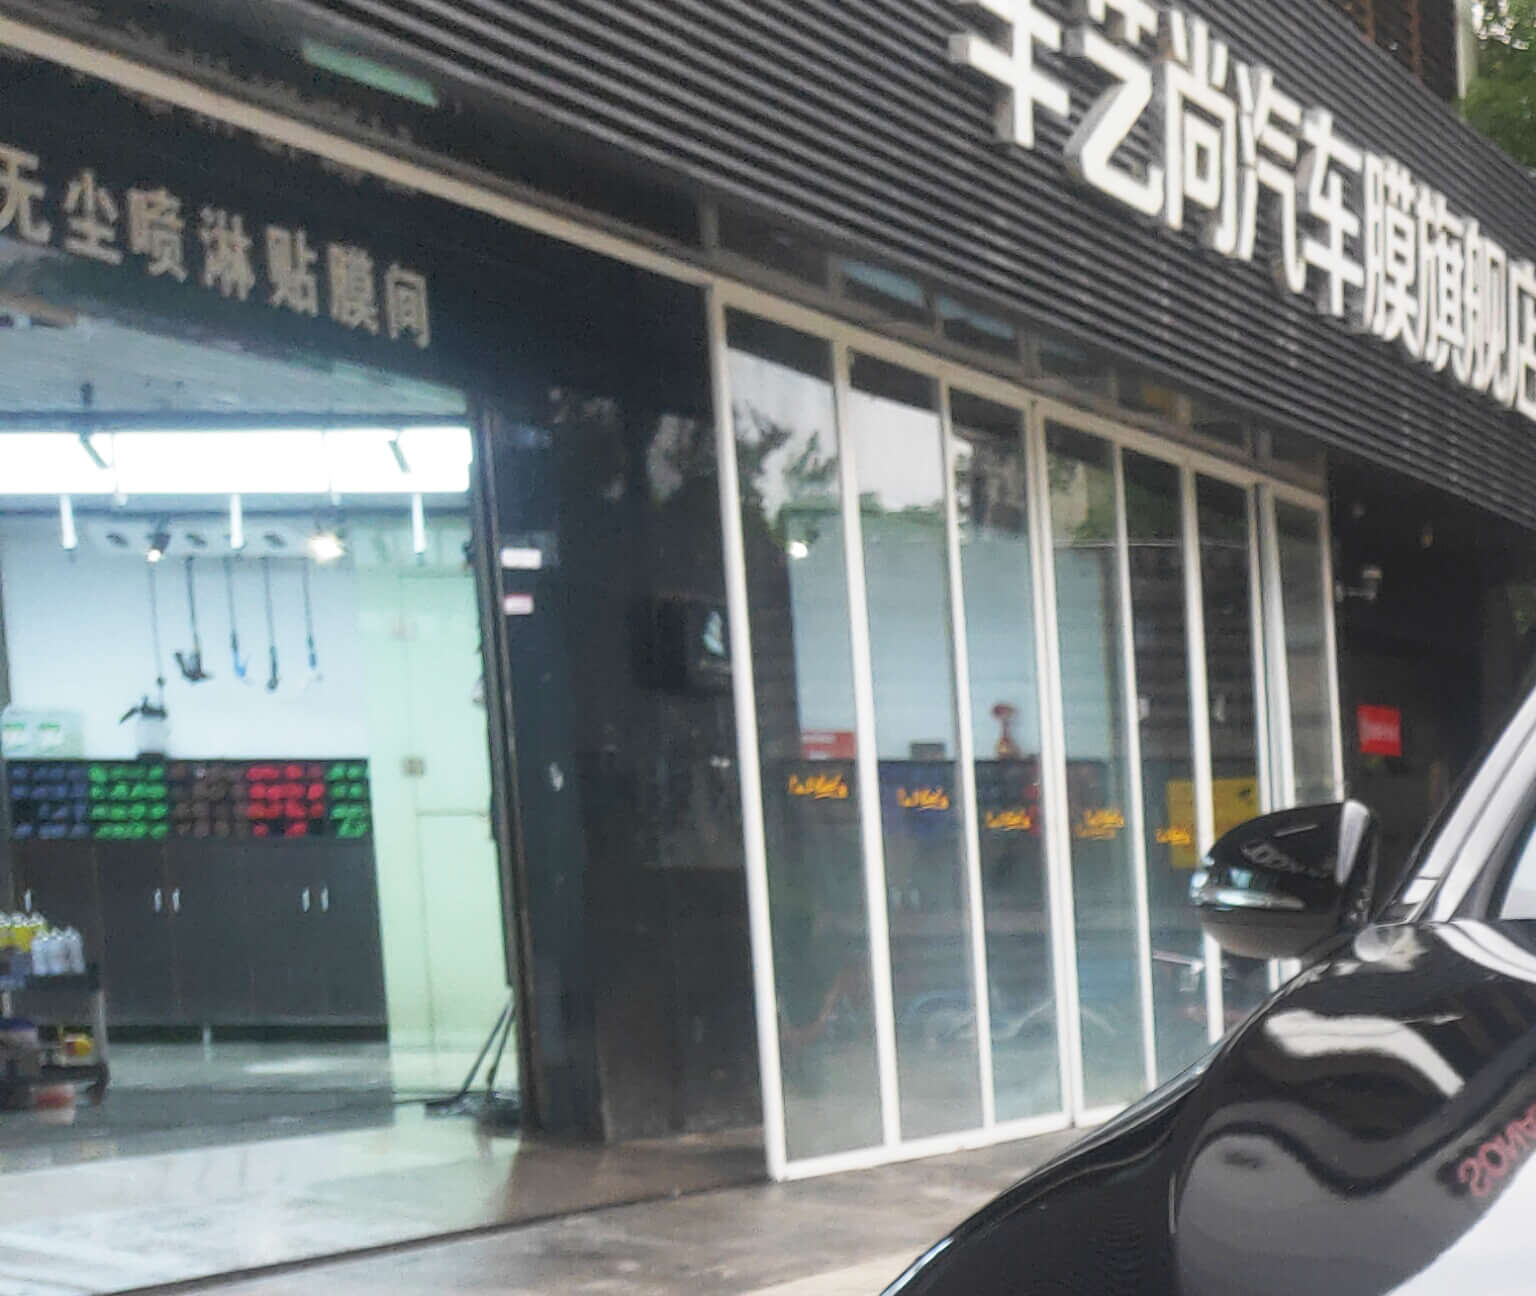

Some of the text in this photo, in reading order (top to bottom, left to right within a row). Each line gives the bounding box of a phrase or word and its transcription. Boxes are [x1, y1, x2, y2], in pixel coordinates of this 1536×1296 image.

[0, 143, 431, 349] 无尘喷淋贴膜间
